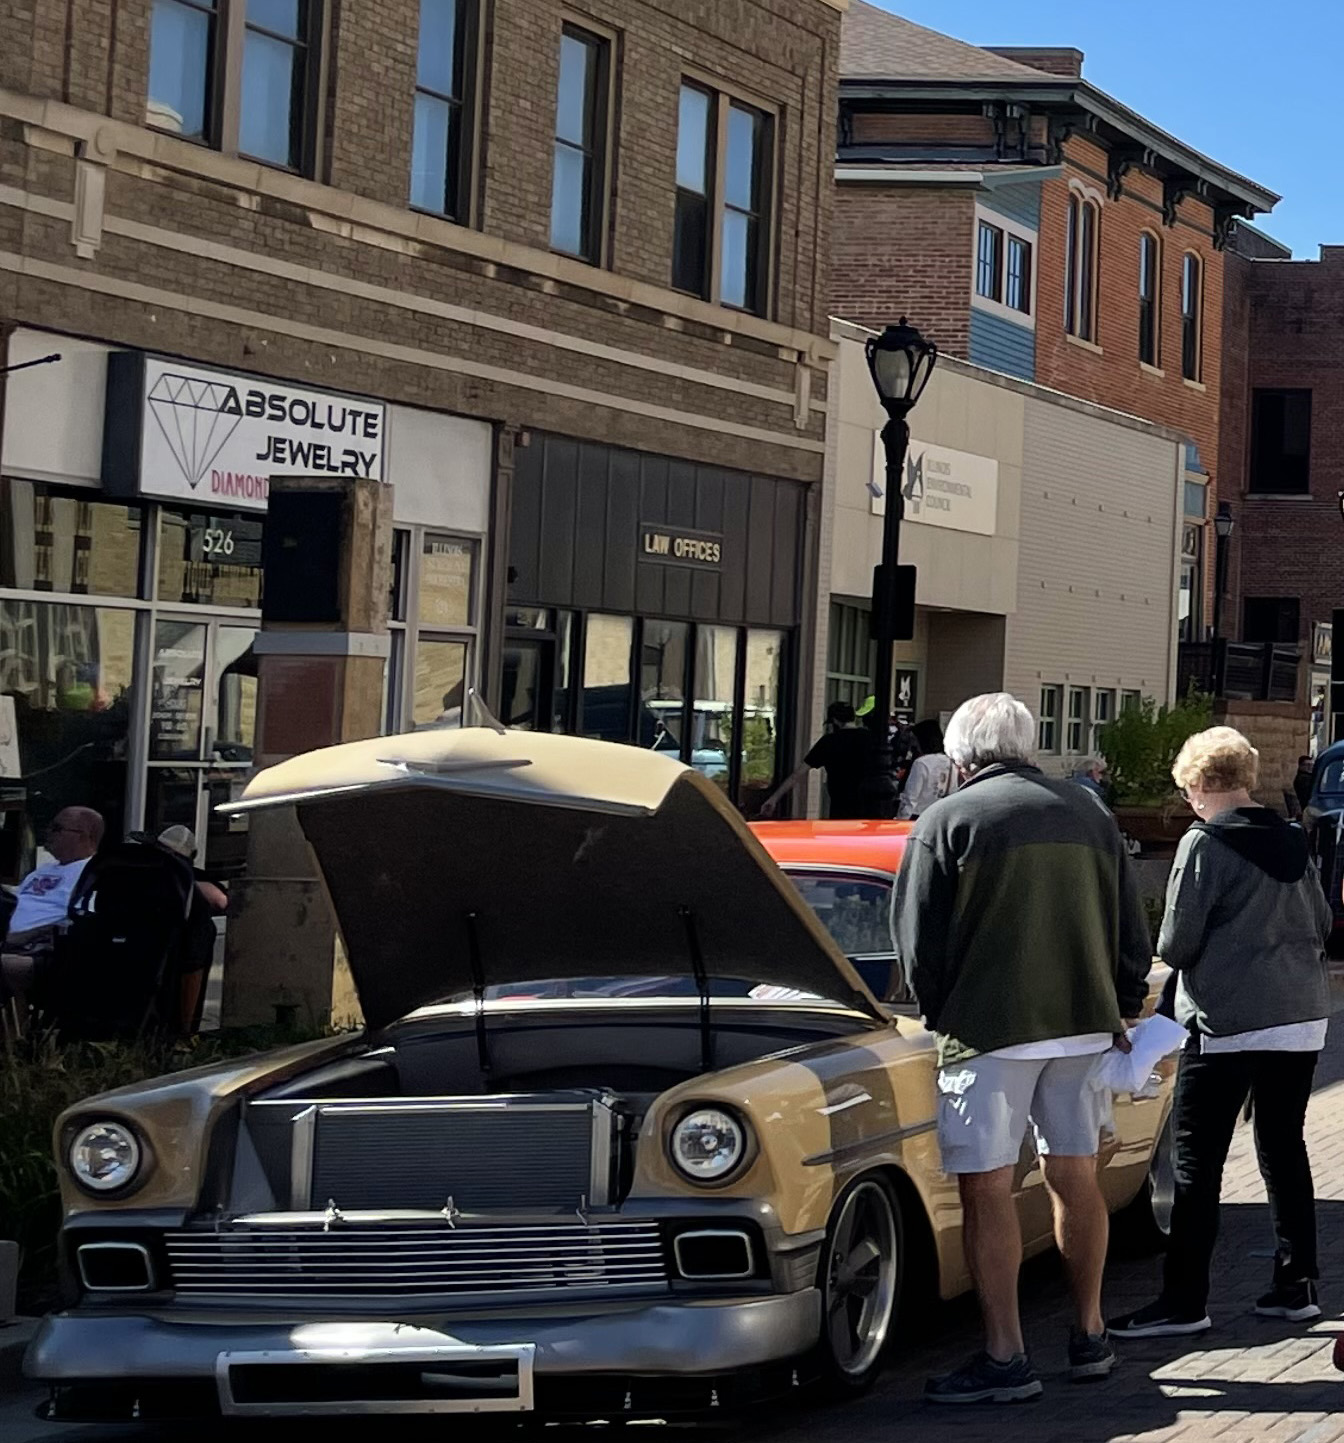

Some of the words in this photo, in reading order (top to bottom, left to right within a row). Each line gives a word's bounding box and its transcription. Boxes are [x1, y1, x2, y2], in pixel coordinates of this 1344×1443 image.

[219, 387, 379, 439] ABSOLUTE
[256, 436, 377, 477] JEWELRY
[203, 529, 234, 555] 526
[645, 533, 670, 555] LAW
[674, 538, 721, 562] OFFICES
